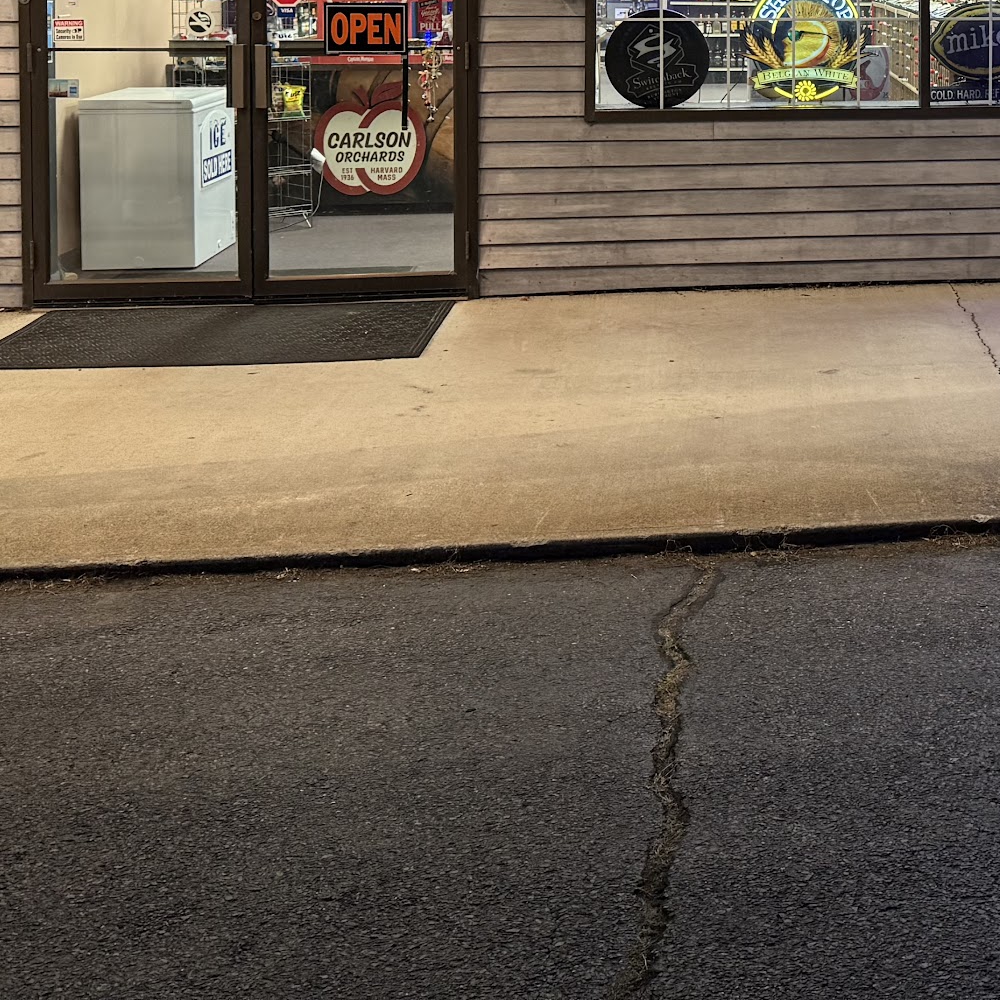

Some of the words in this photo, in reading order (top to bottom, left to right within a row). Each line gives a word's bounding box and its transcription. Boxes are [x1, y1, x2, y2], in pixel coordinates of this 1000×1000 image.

[330, 11, 402, 45] OPEN
[420, 22, 441, 31] PULL
[632, 68, 692, 89] Switcback
[763, 68, 810, 80] BELGAN
[814, 68, 850, 80] WHITE
[209, 118, 227, 150] ICE
[327, 131, 412, 149] CARLSON
[335, 151, 405, 163] ORCHARDS
[370, 166, 403, 174] HARVARD
